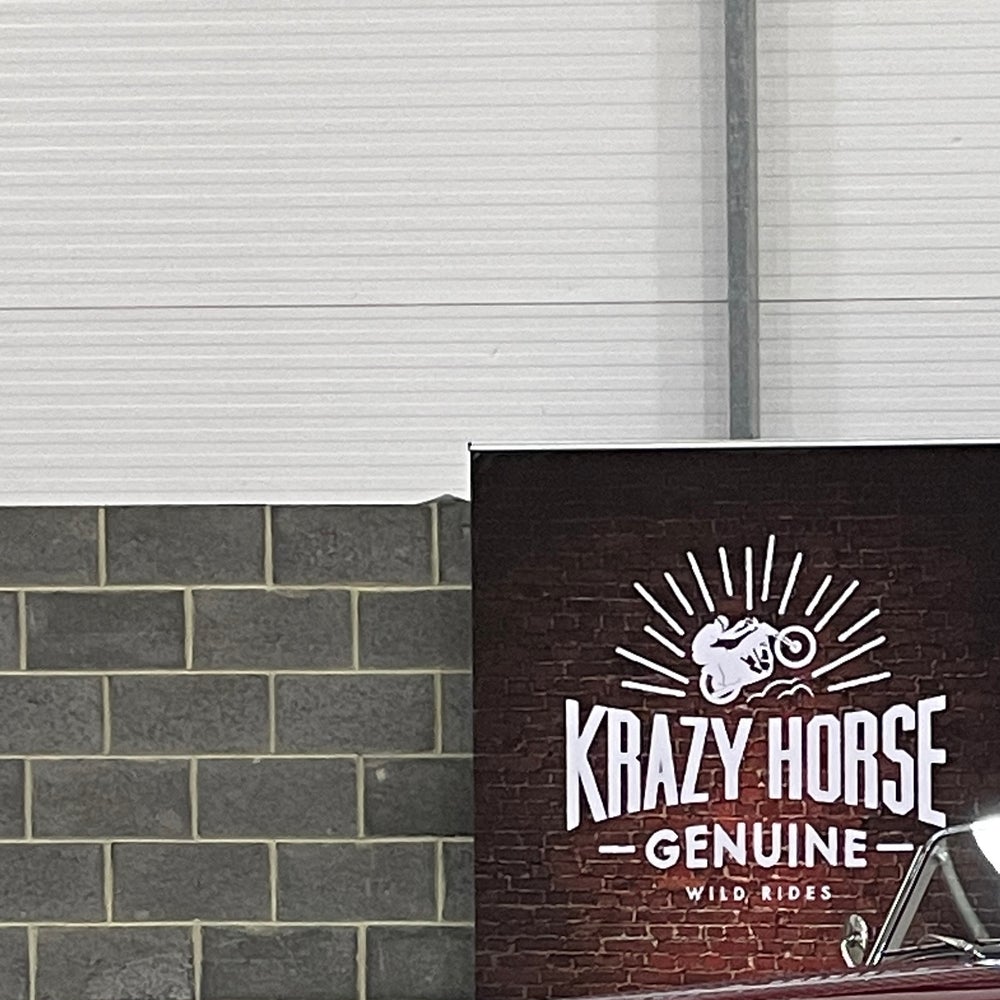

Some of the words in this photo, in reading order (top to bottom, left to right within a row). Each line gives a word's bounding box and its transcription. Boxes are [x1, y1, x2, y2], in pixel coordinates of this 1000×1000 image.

[565, 698, 753, 831] KRAZY
[767, 694, 947, 828] HORSE
[644, 822, 868, 870] GENUINE
[685, 885, 746, 901] WILD
[760, 884, 833, 901] RIDES
